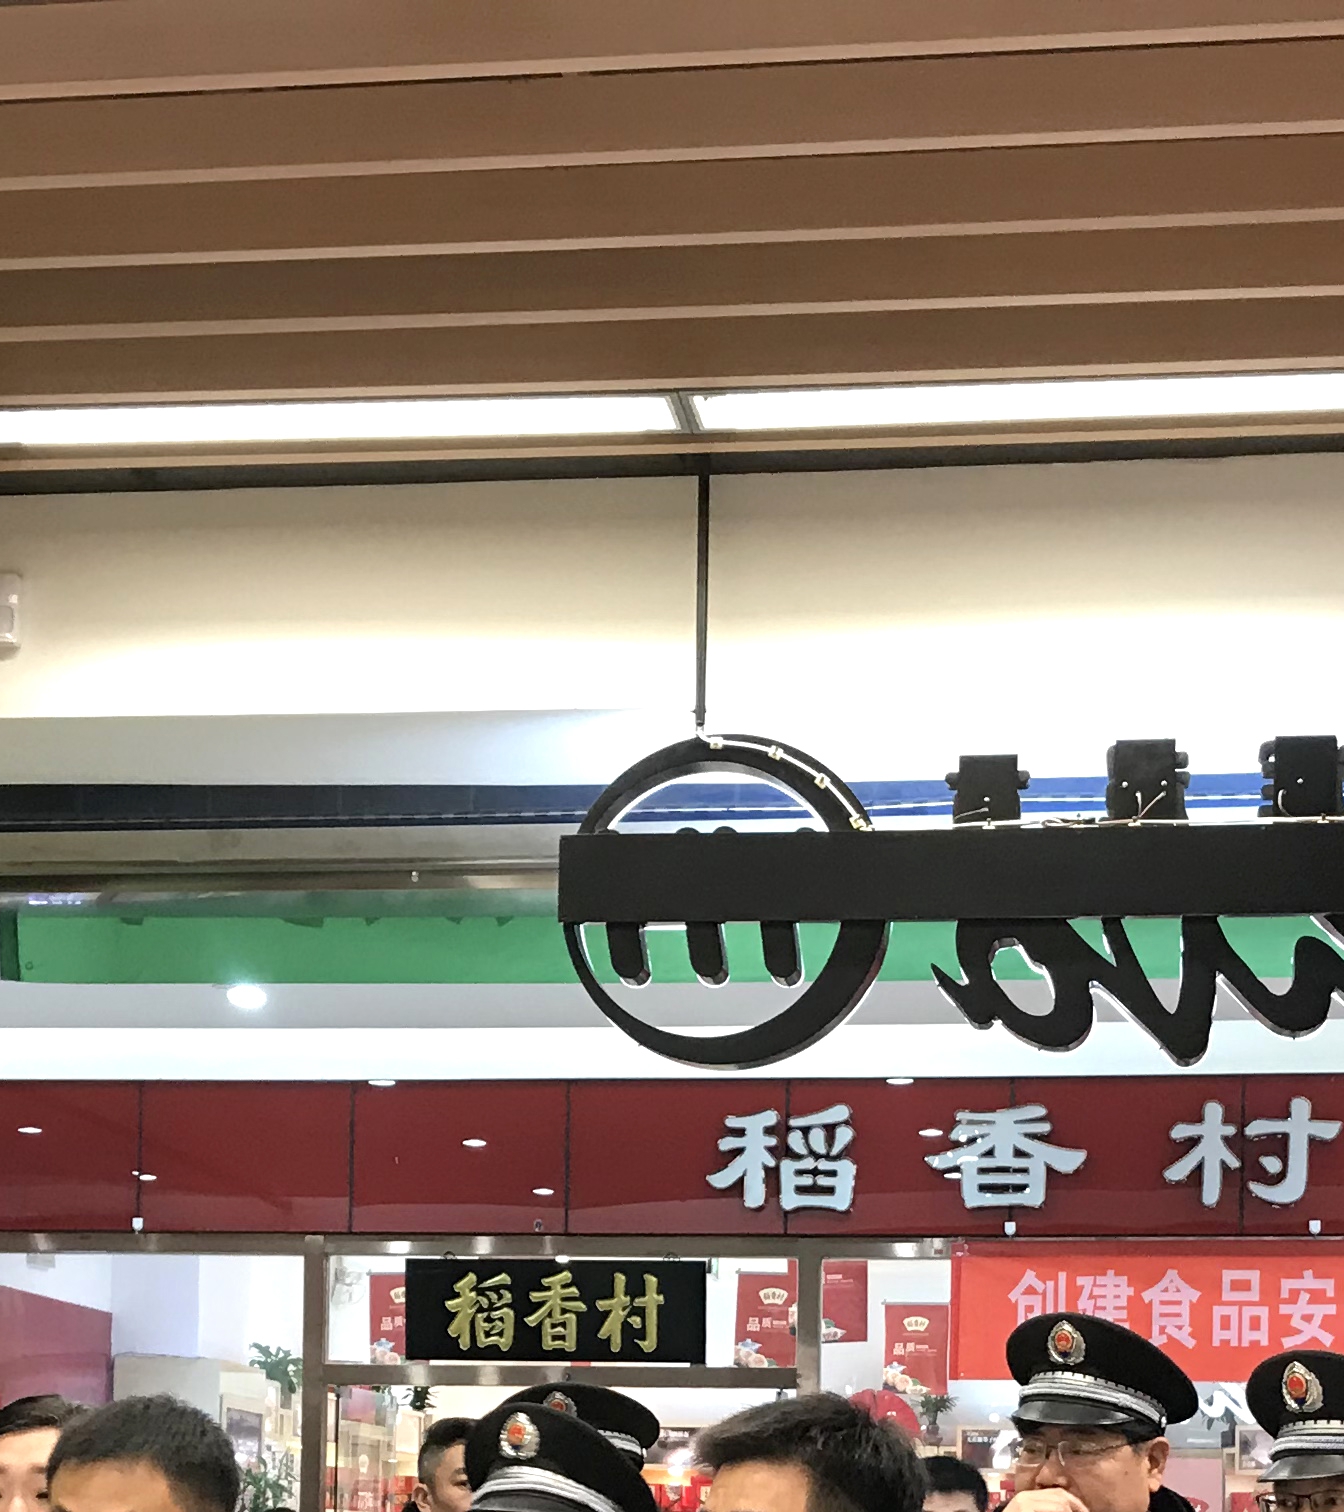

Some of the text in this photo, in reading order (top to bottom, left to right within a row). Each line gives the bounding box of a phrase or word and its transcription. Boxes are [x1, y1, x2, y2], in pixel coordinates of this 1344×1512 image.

[705, 1096, 1343, 1214] 稻香村
[444, 1270, 665, 1353] 稻香村
